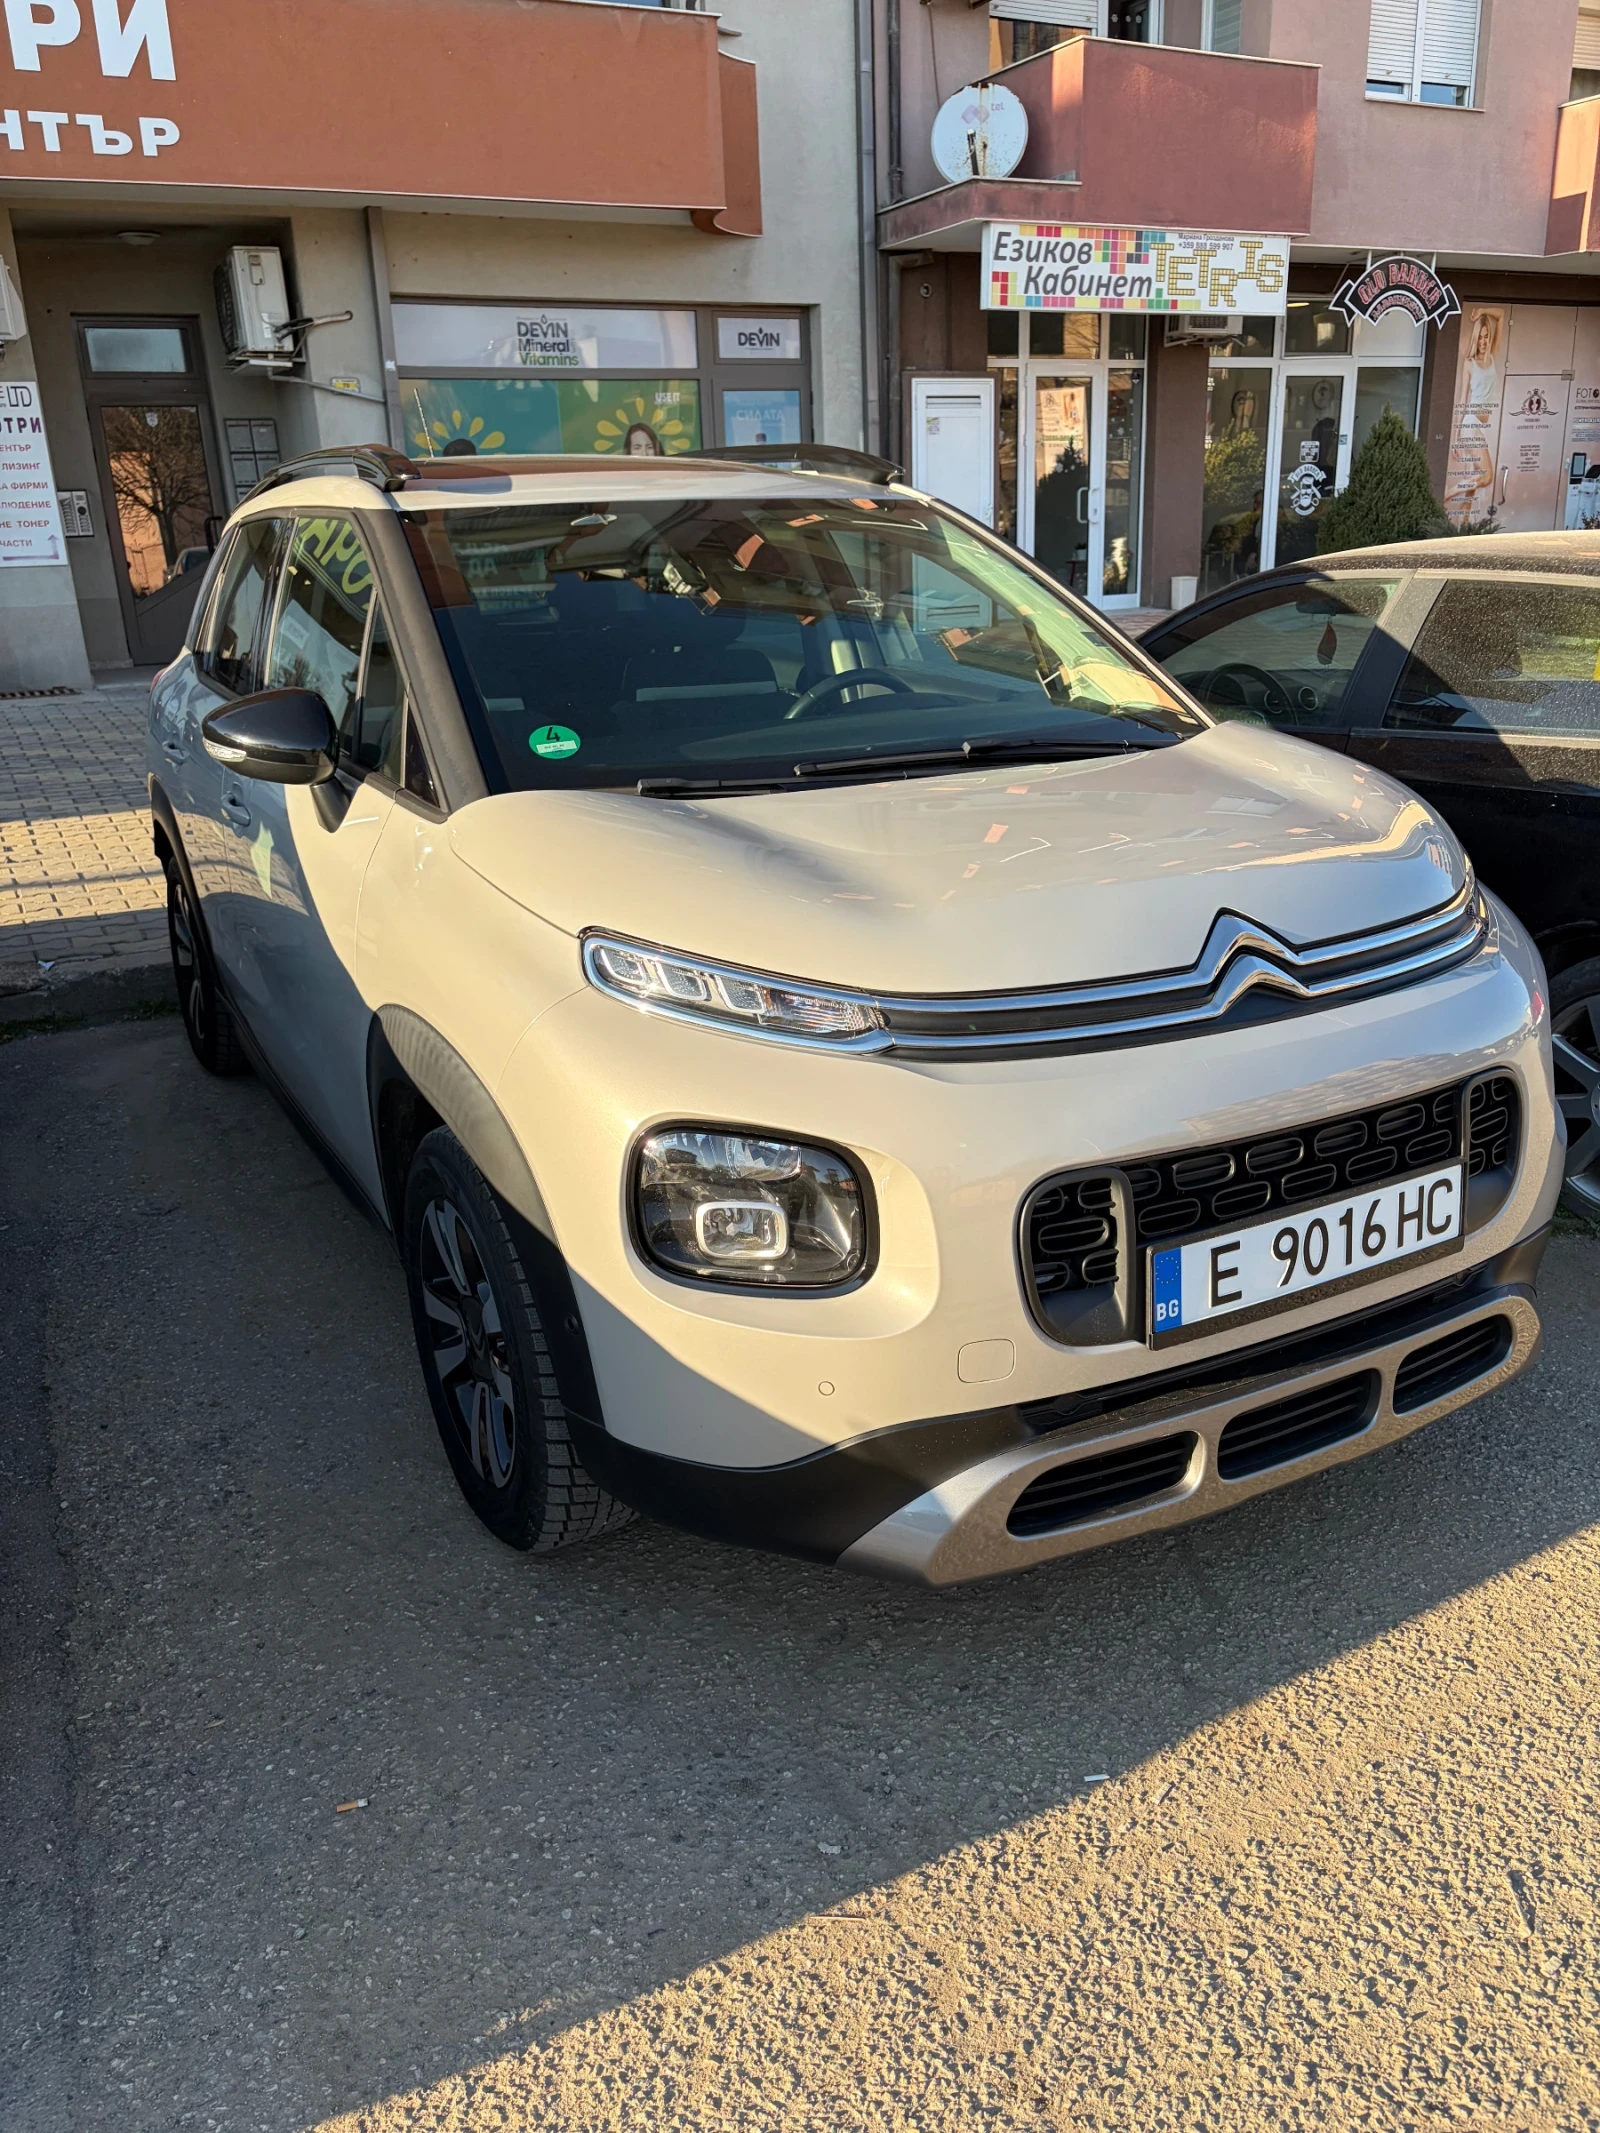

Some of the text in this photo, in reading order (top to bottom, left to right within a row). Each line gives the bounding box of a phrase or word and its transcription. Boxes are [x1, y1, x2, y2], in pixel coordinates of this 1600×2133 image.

[993, 231, 1093, 264] Езиков
[1178, 241, 1194, 249] +359
[1209, 242, 1221, 250] 599
[1024, 265, 1152, 297] Кабинет
[1388, 263, 1442, 309] BARBER
[517, 321, 569, 338] DEVIN
[518, 339, 570, 353] Mineral
[738, 332, 781, 347] DEVIN
[519, 352, 579, 366] Vitamins
[0, 417, 42, 434] ТРИ
[2, 462, 41, 470] ЛИЗИНГ
[10, 482, 48, 490] ФИРМИ
[0, 500, 52, 509] ЛЮДЕНИЕ
[16, 520, 50, 528] ТОНЕР
[546, 726, 561, 742] 4
[1209, 1178, 1453, 1308] E 9016 HC
[1156, 1298, 1179, 1323] BG
